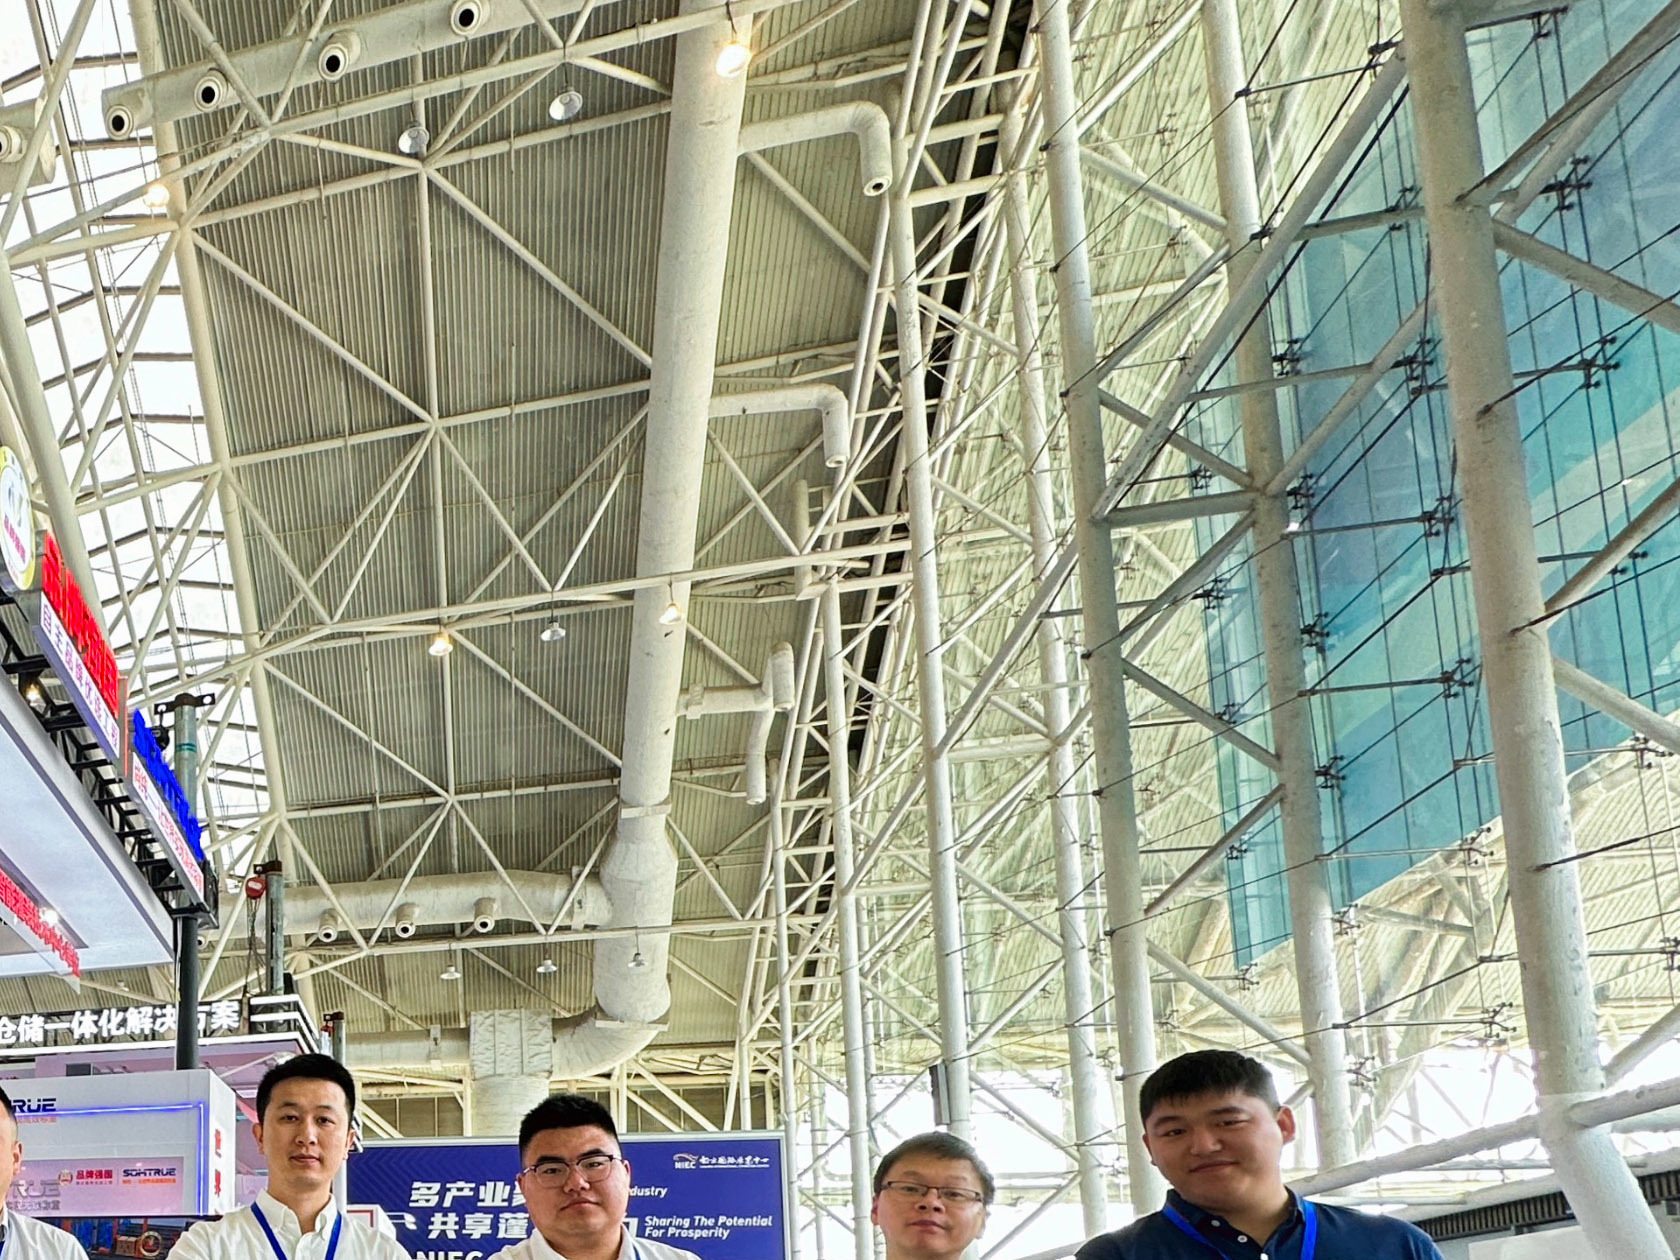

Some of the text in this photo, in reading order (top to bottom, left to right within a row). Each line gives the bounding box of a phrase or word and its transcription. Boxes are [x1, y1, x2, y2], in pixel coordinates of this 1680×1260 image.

[42, 530, 120, 719] 品牌强国
[644, 1215, 690, 1229] Sharing
[694, 1215, 715, 1226] The
[717, 1215, 773, 1227] Potential
[645, 1227, 663, 1237] For
[667, 1227, 730, 1240] Prosperity
